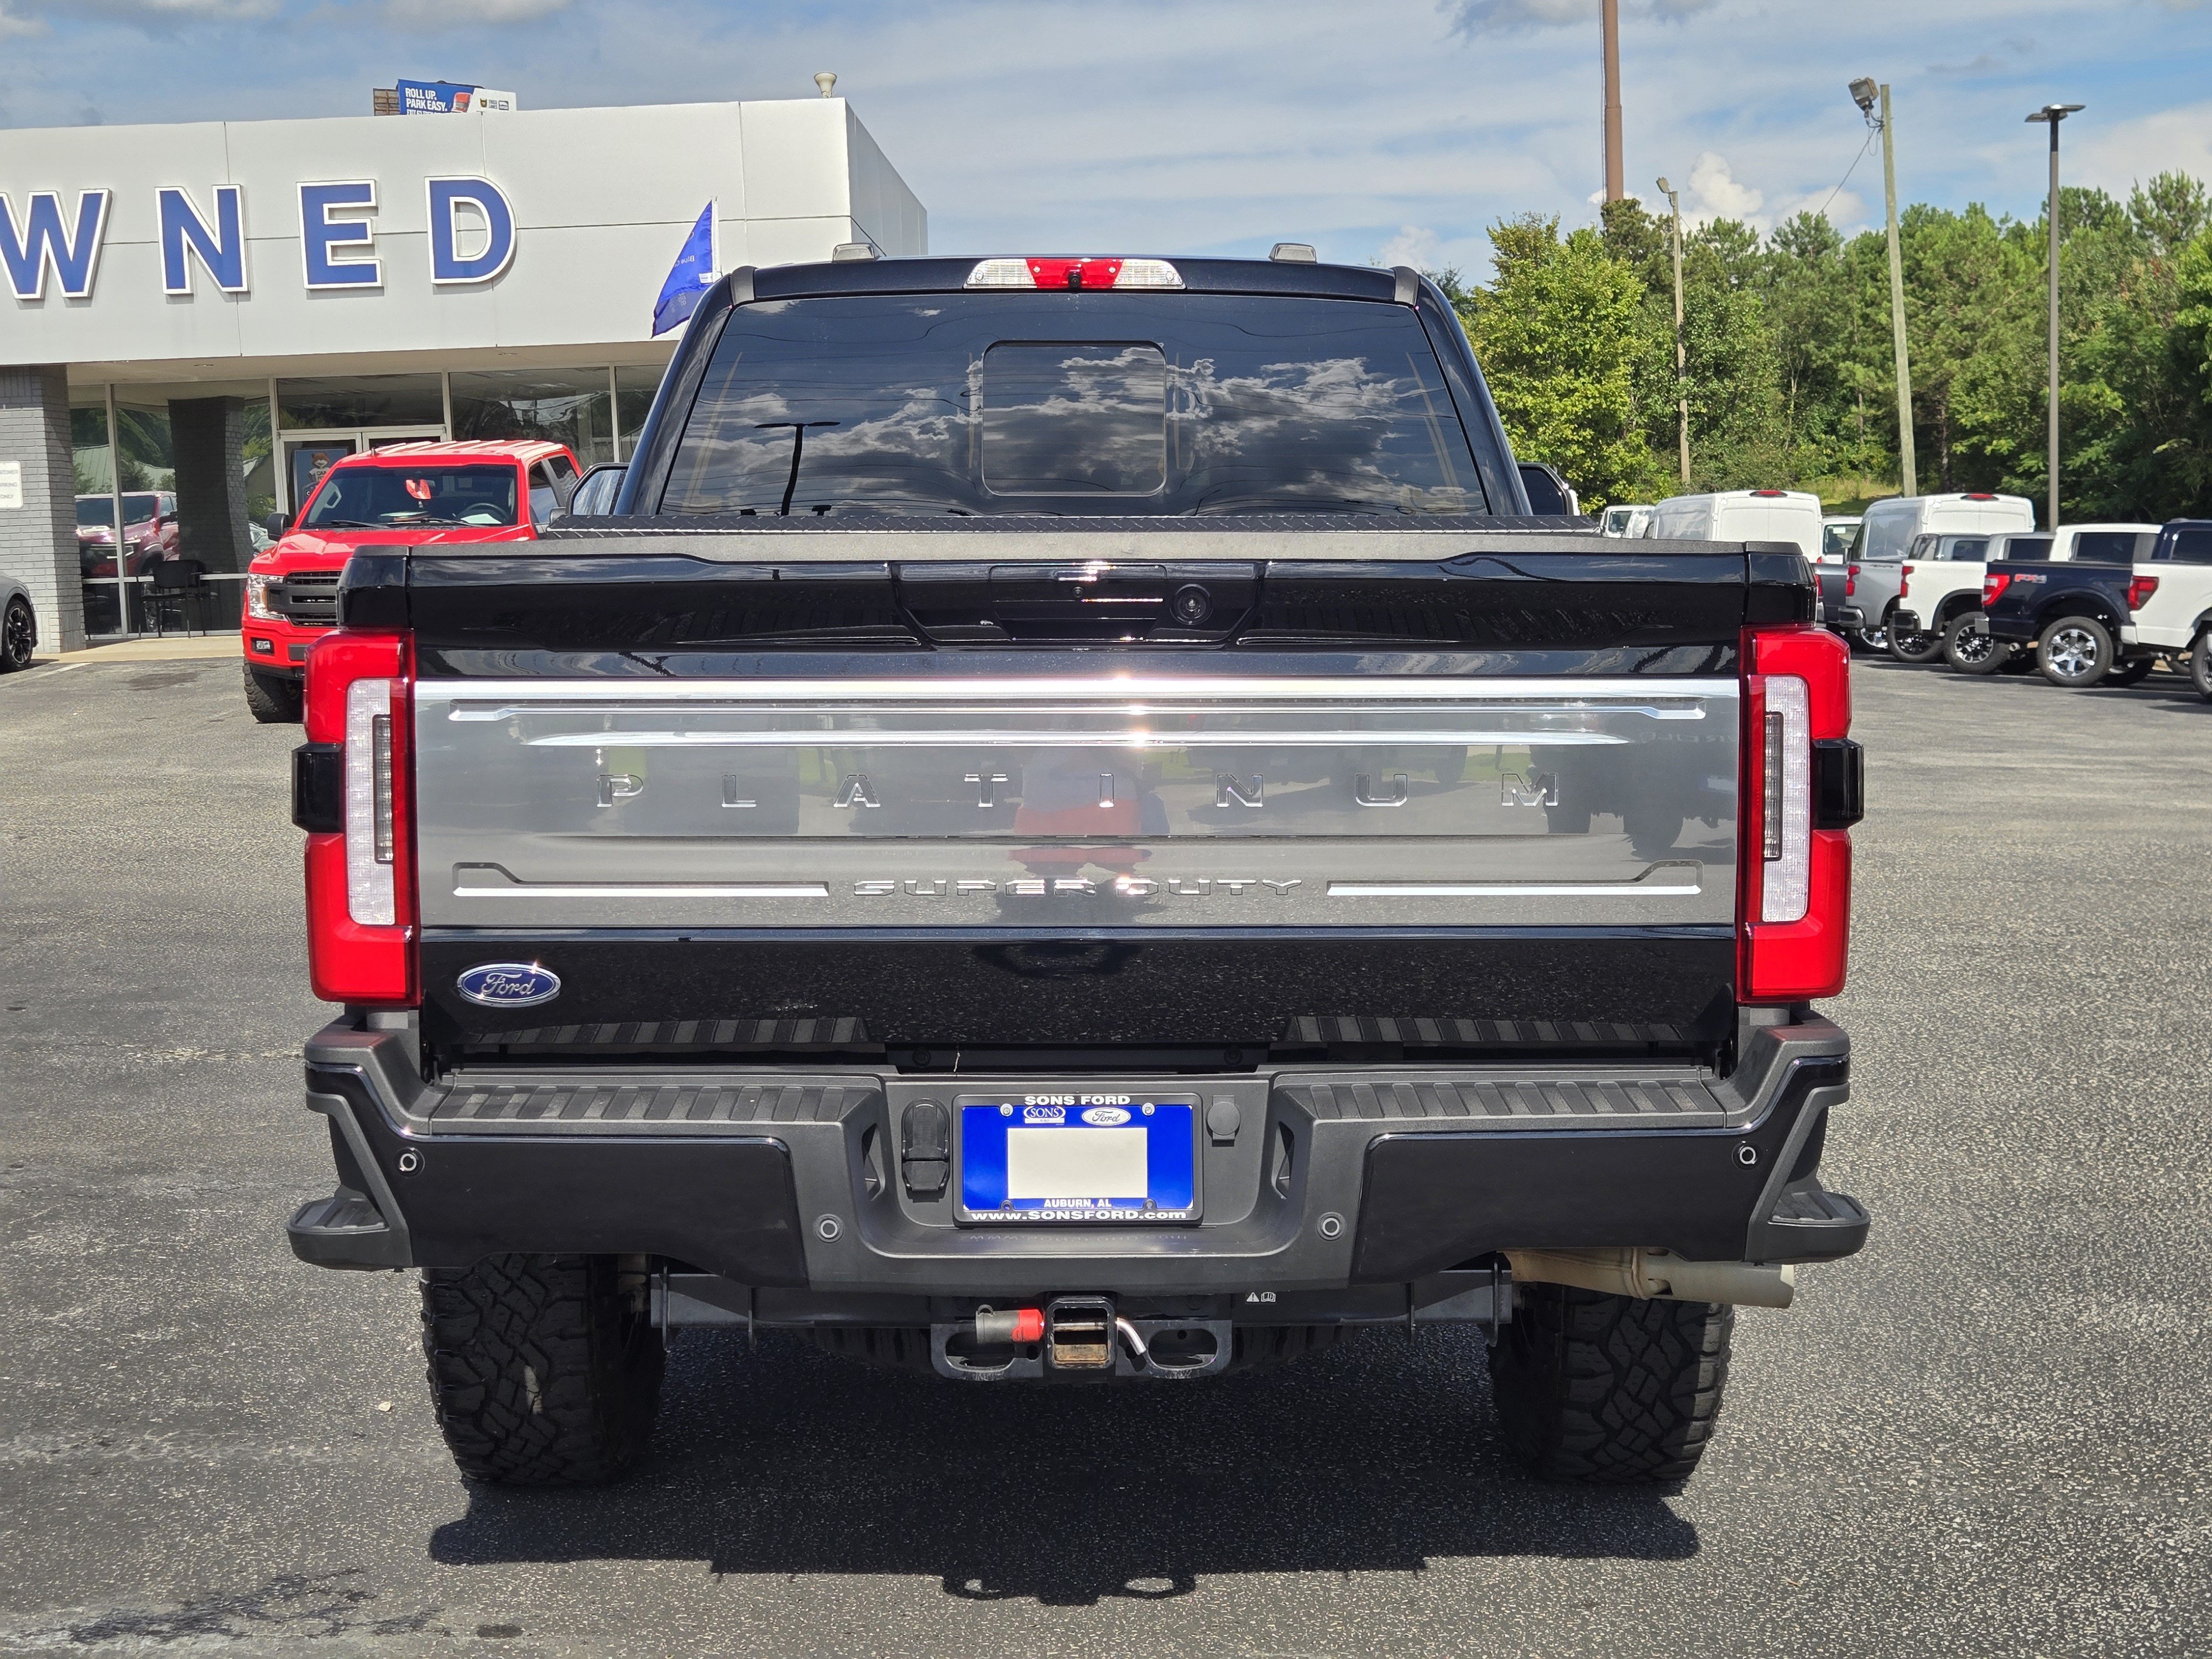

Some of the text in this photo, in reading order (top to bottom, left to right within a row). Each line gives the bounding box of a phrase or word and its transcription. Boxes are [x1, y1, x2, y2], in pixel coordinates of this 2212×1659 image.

[405, 88, 437, 100] ROLL UP.
[406, 98, 448, 111] PARK EASY.
[0, 175, 517, 299] WNED
[2015, 573, 2047, 584] FX4
[596, 773, 1559, 808] PLATINUM
[854, 878, 1302, 896] SUPER DUTY
[481, 972, 536, 995] Ford
[1024, 1095, 1131, 1105] SONS FORD
[1030, 1108, 1060, 1118] SONS
[1092, 1110, 1121, 1123] Ford
[1044, 1199, 1112, 1209] AUBURN, AL
[971, 1210, 1187, 1220] www.SONSFORD.com
